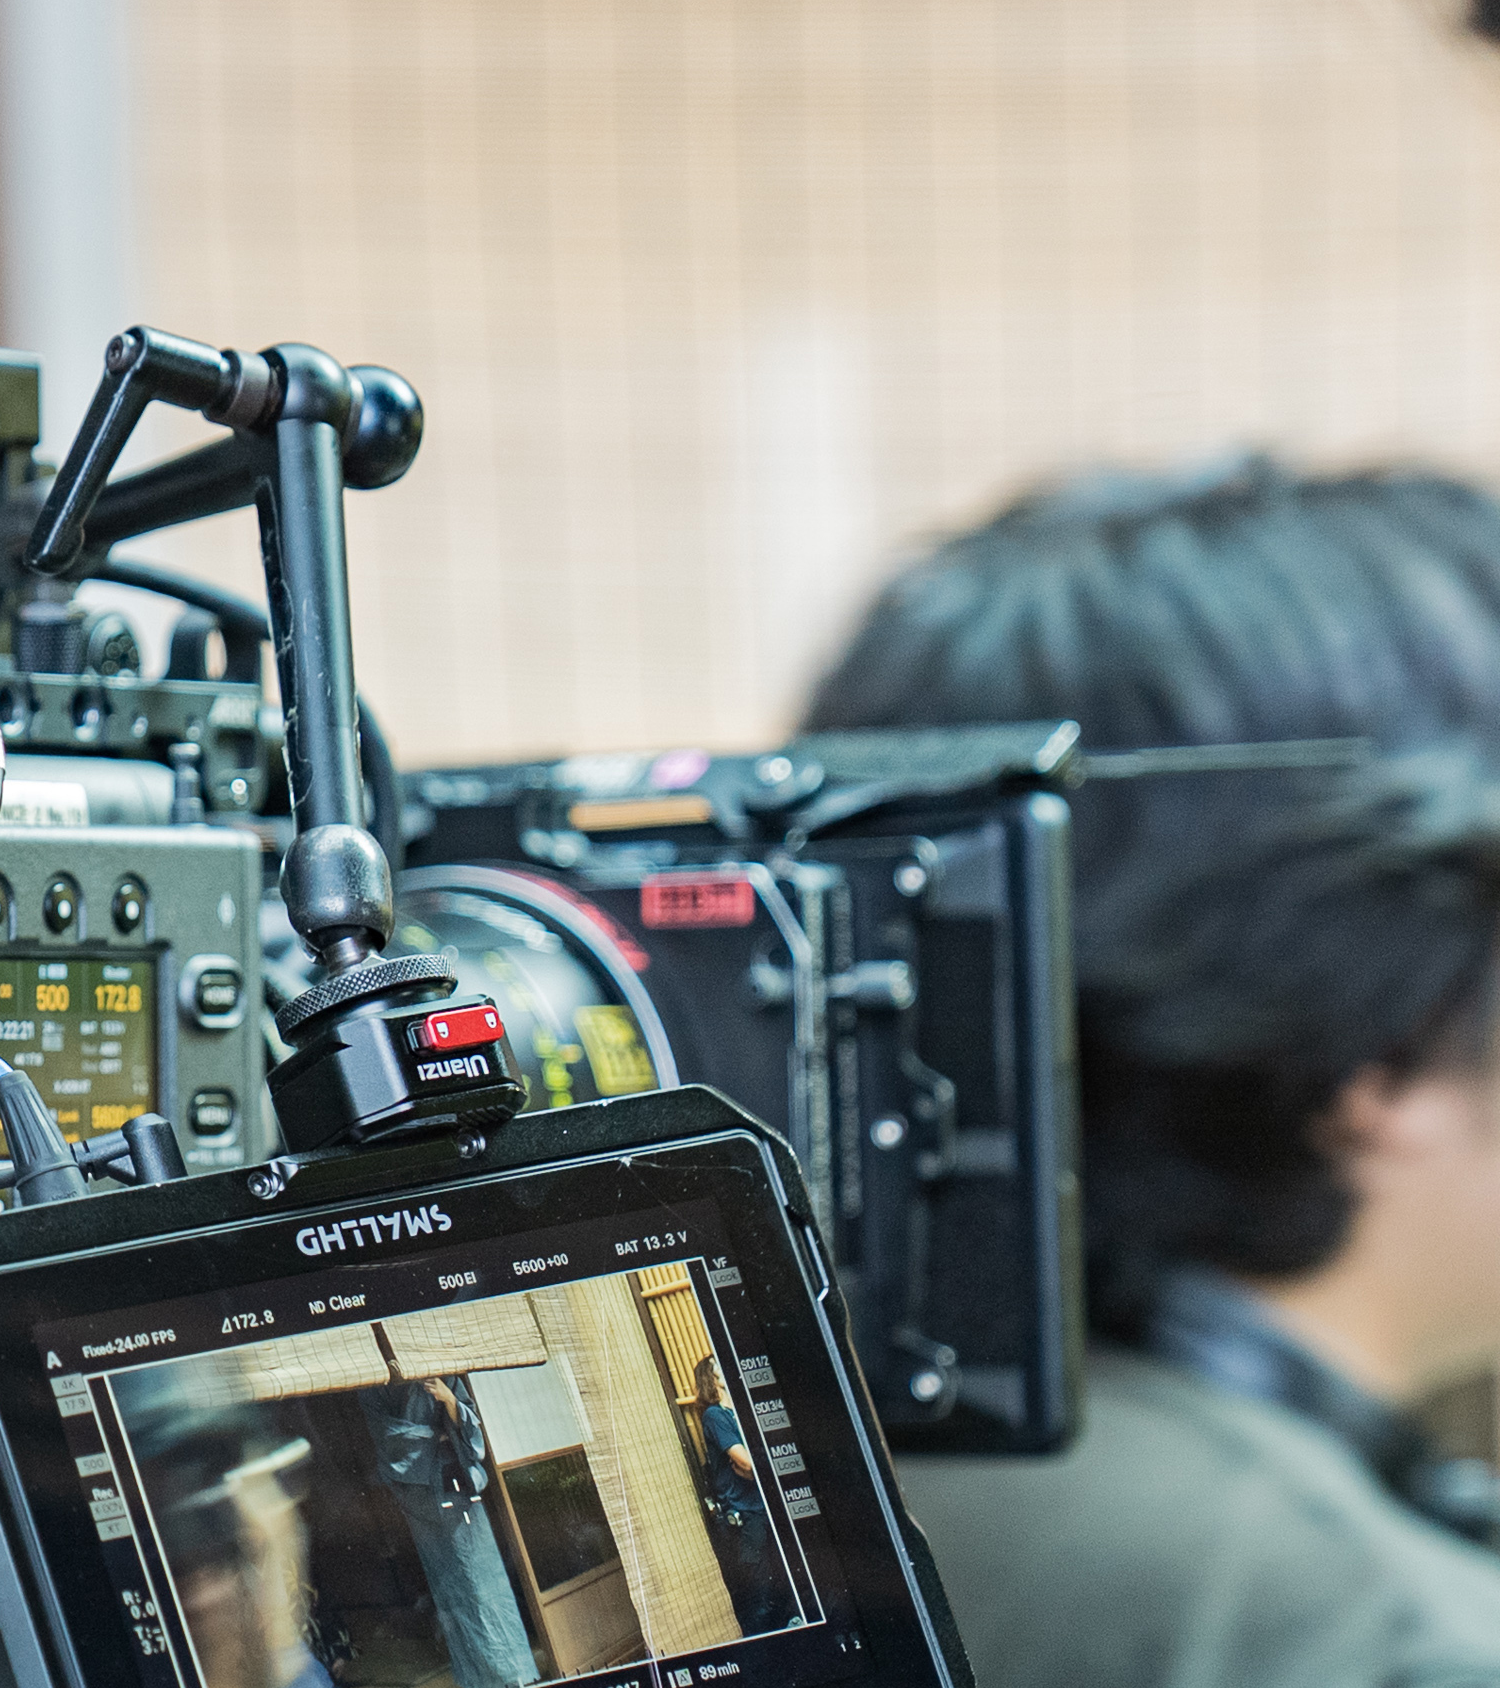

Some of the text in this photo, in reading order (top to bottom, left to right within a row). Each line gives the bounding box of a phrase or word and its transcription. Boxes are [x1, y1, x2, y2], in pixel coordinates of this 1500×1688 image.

[36, 984, 70, 1011] 500
[95, 984, 143, 1012] 172.8
[417, 1053, 491, 1082] Ulanzi
[295, 1203, 453, 1256] SMALLHD
[712, 1256, 729, 1270] VF
[714, 1270, 739, 1285] Look
[151, 1328, 177, 1345] FPS
[308, 1301, 326, 1316] ND
[329, 1293, 367, 1312] Clear
[614, 1240, 640, 1257] BAT
[46, 1351, 62, 1370] A
[750, 1372, 770, 1385] LOG
[763, 1414, 788, 1429] Look
[771, 1442, 798, 1458] MON
[778, 1457, 803, 1473] Look
[785, 1486, 813, 1502] HDMI
[792, 1500, 818, 1516] Look
